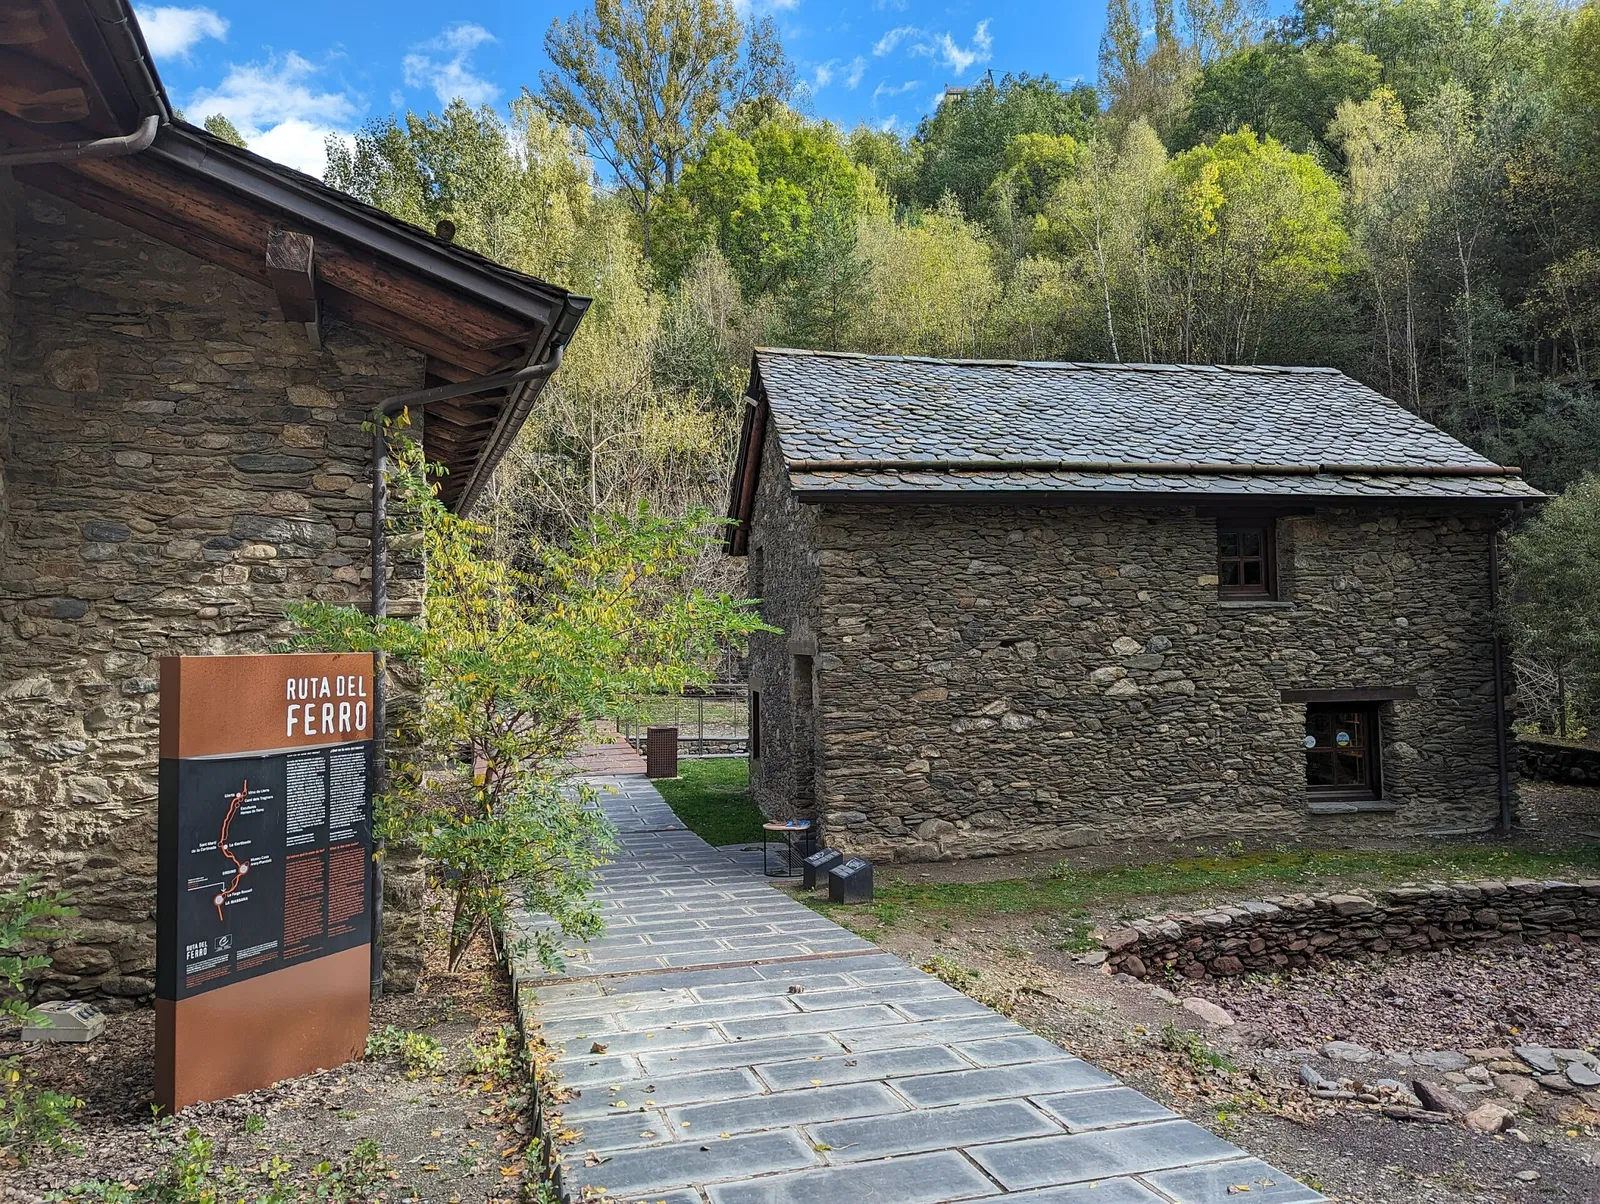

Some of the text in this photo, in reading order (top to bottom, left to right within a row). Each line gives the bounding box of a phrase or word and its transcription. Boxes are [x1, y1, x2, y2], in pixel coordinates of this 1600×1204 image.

[286, 675, 367, 700] RUTA DEL
[286, 701, 367, 737] FERRO
[198, 940, 208, 948] DEL
[186, 947, 208, 961] FERRO
